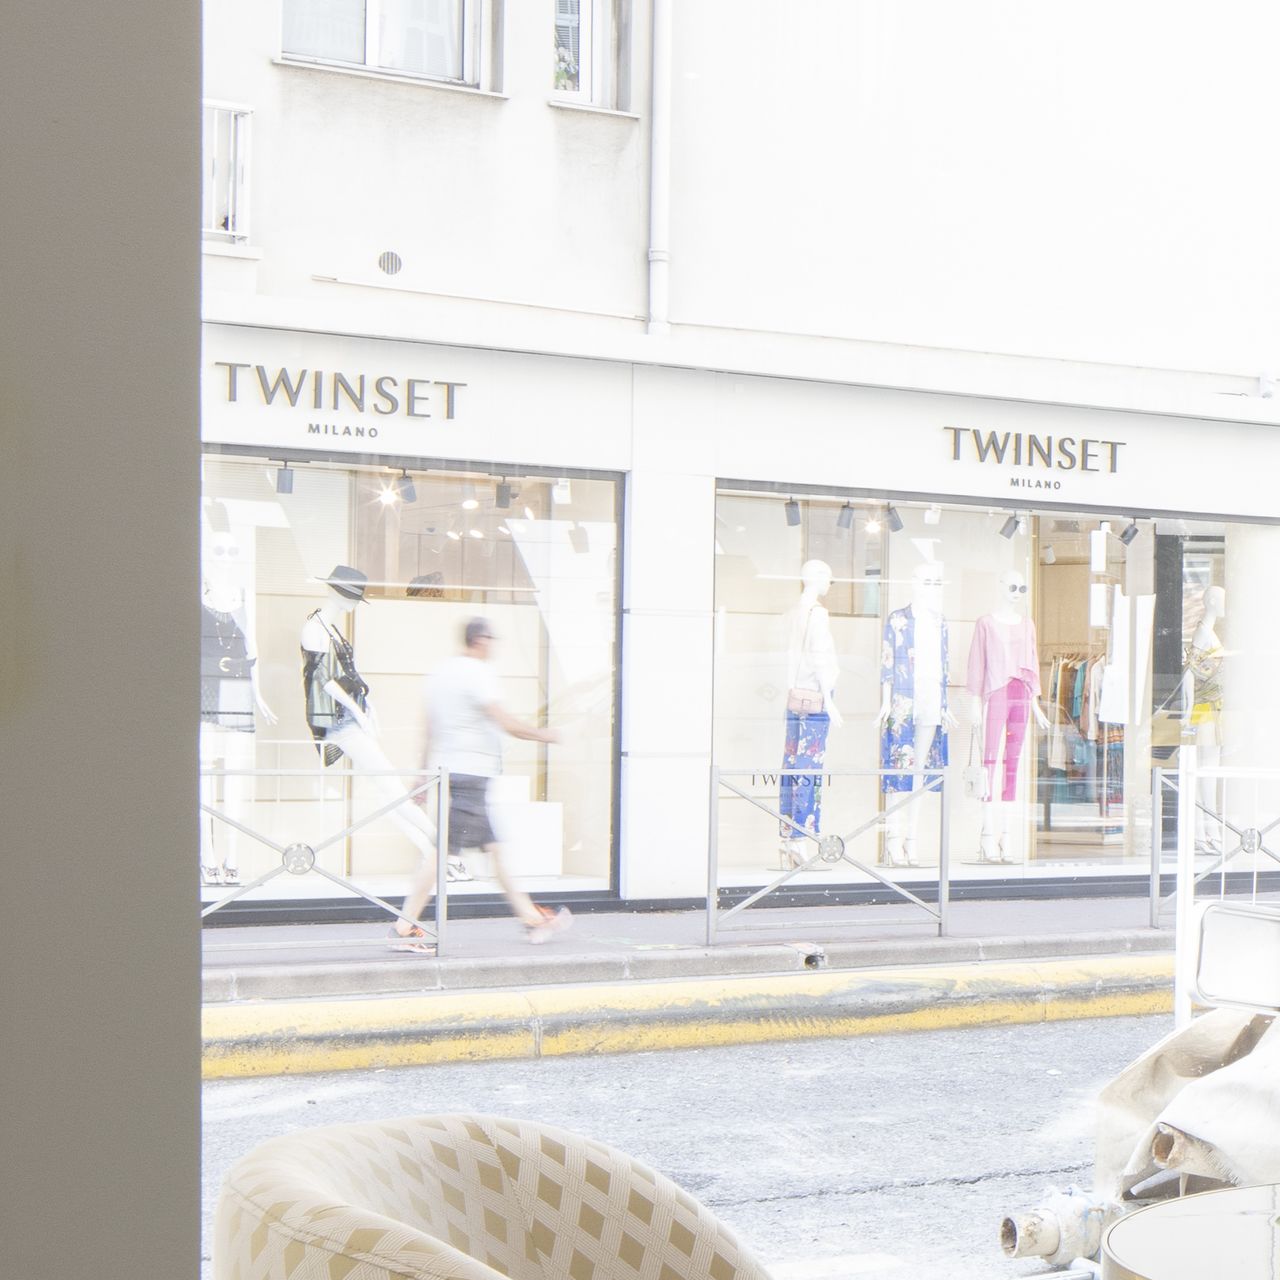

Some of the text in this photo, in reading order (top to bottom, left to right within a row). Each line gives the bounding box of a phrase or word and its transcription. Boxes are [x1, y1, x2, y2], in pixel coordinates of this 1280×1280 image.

[214, 361, 468, 420] TWINSET
[307, 423, 379, 438] MILANO
[943, 426, 1127, 473] TWINSET
[1010, 477, 1062, 490] MILANO
